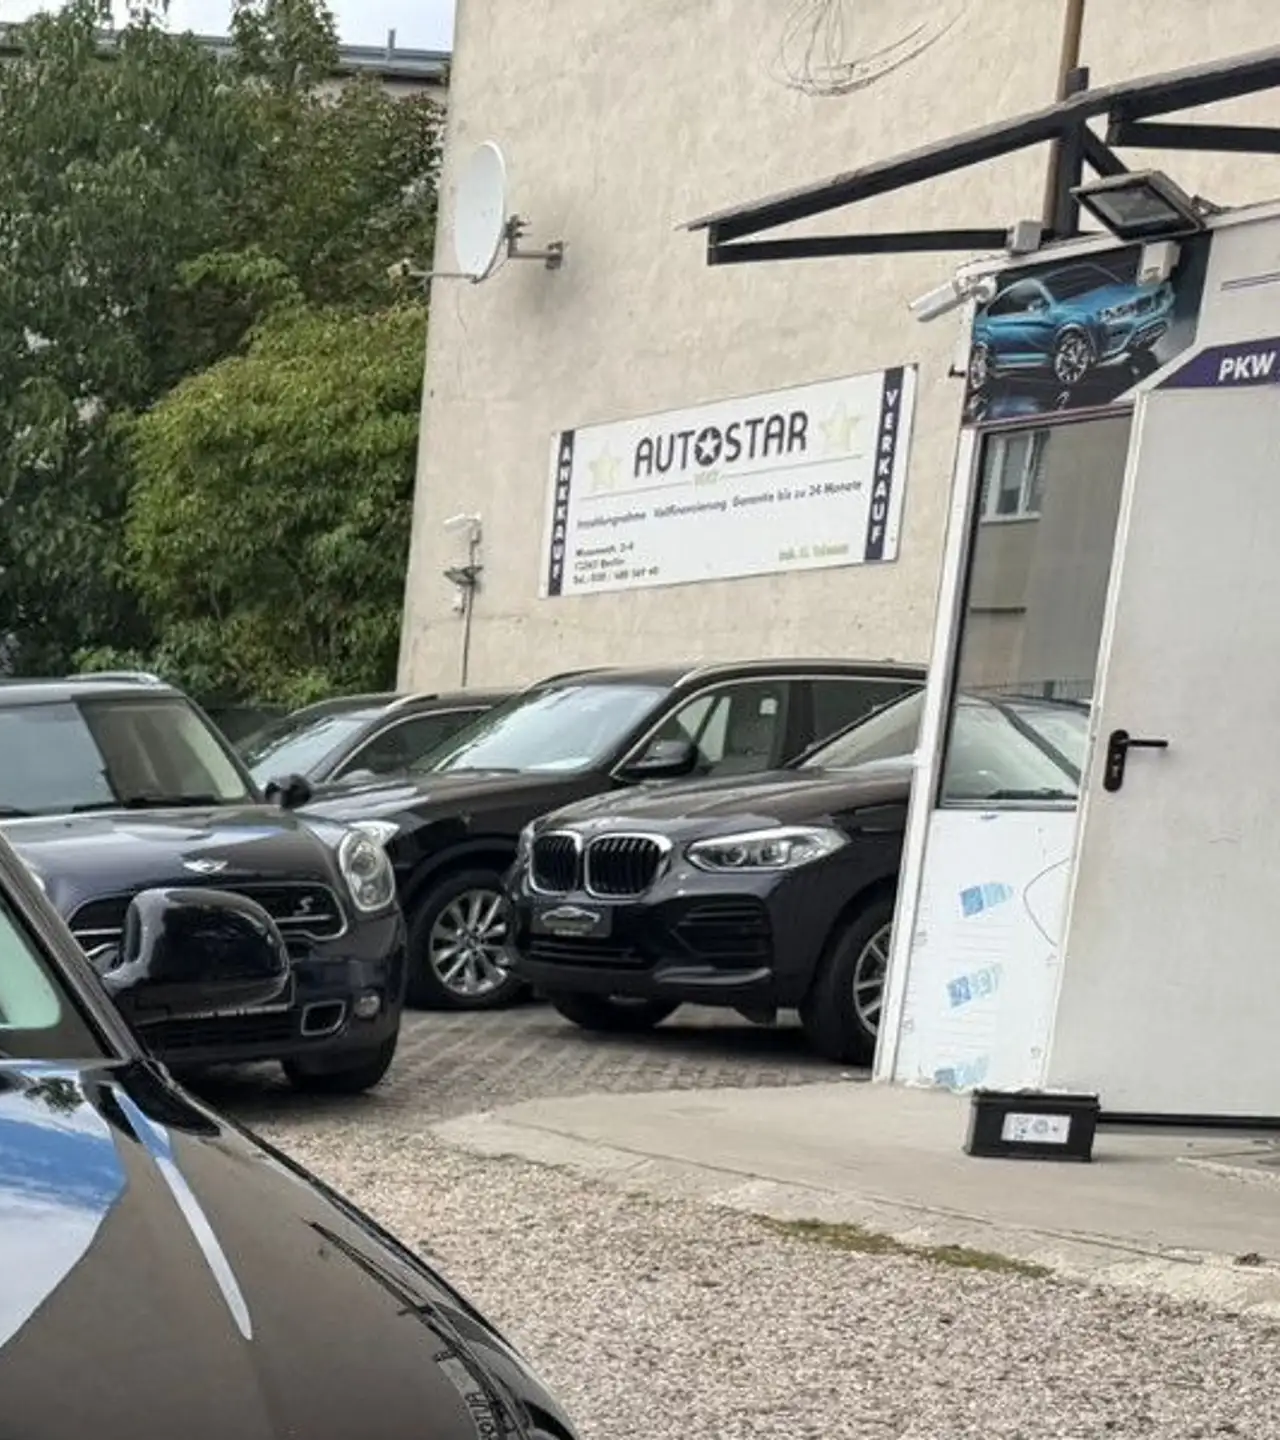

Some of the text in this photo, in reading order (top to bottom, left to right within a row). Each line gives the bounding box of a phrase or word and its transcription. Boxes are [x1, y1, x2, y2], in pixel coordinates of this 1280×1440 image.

[1219, 351, 1276, 381] PKW
[634, 411, 809, 478] AUTOSTAR
[872, 388, 899, 545] VERKAUF
